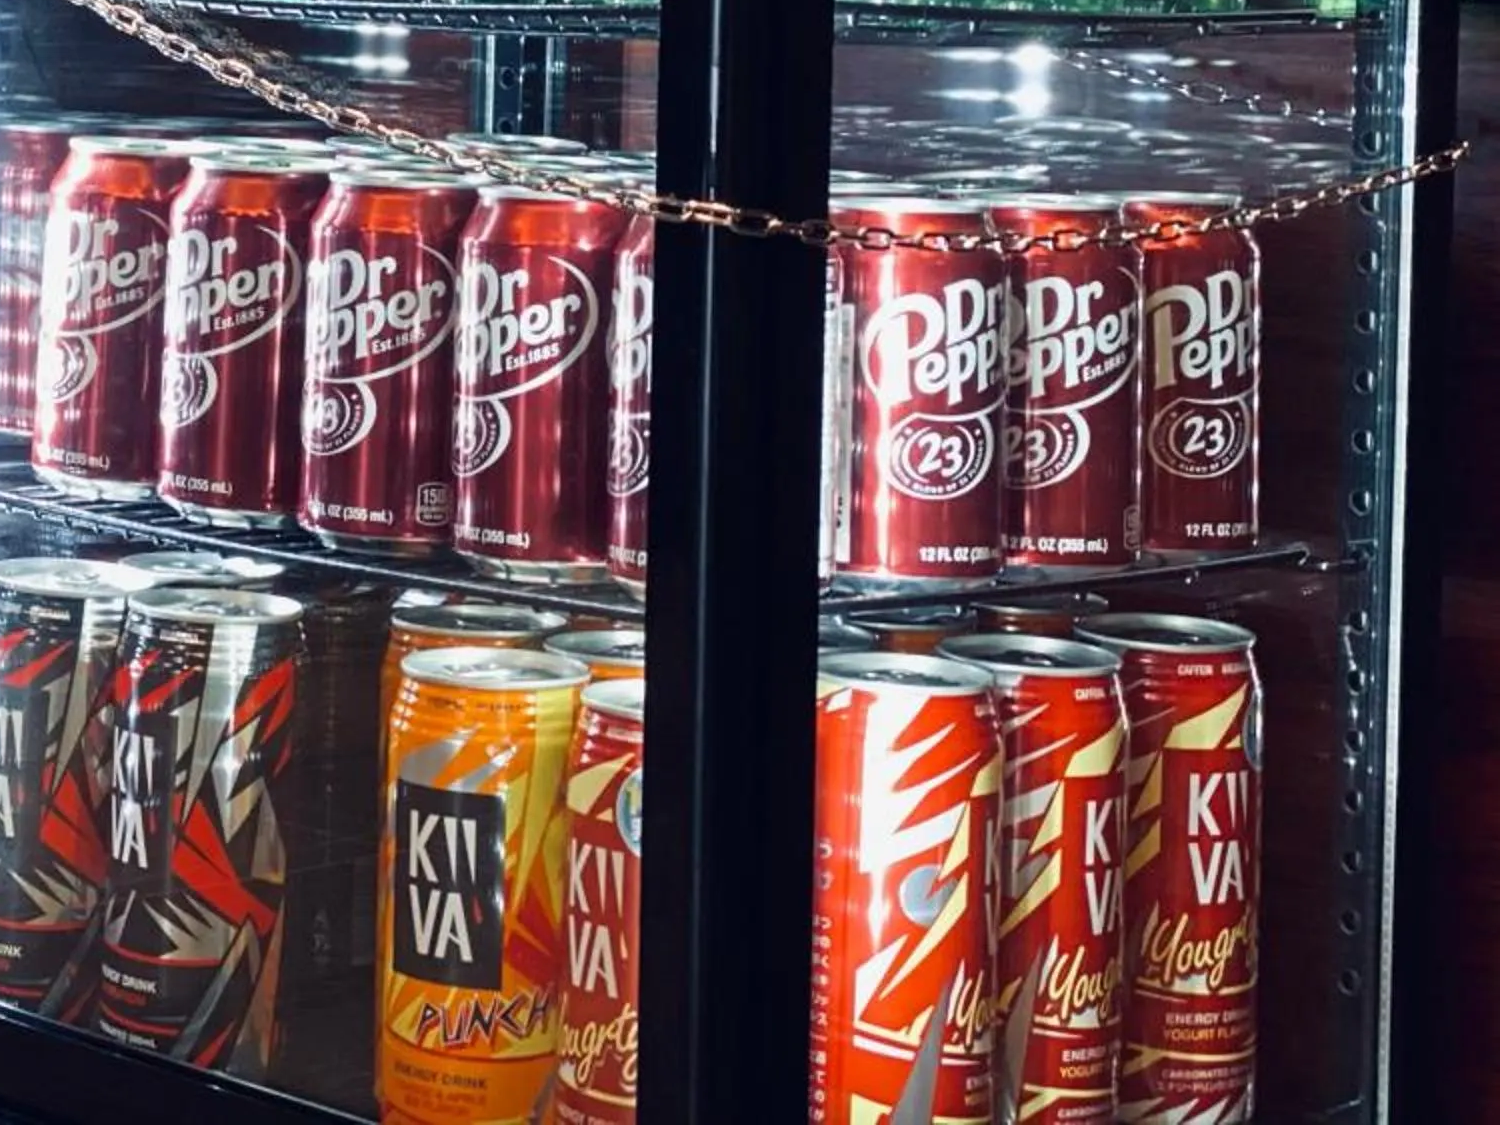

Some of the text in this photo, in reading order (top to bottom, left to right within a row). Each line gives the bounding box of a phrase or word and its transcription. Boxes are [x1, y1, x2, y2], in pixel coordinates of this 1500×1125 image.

[60, 244, 165, 321] pper
[174, 261, 285, 343] pper
[328, 249, 397, 310] Dr
[460, 262, 529, 323] Dr
[1025, 277, 1105, 342] Dr
[866, 293, 1003, 406] Pepp
[1148, 284, 1257, 390] Pepp
[918, 432, 963, 477] 23
[1184, 416, 1225, 458] 23
[111, 792, 149, 869] VA
[1187, 770, 1250, 837] KII
[408, 808, 478, 884] KII
[569, 835, 626, 918] KII
[1187, 839, 1245, 906] VA
[408, 883, 474, 963] VA
[567, 913, 618, 1000] VA
[414, 985, 552, 1050] PUNCH
